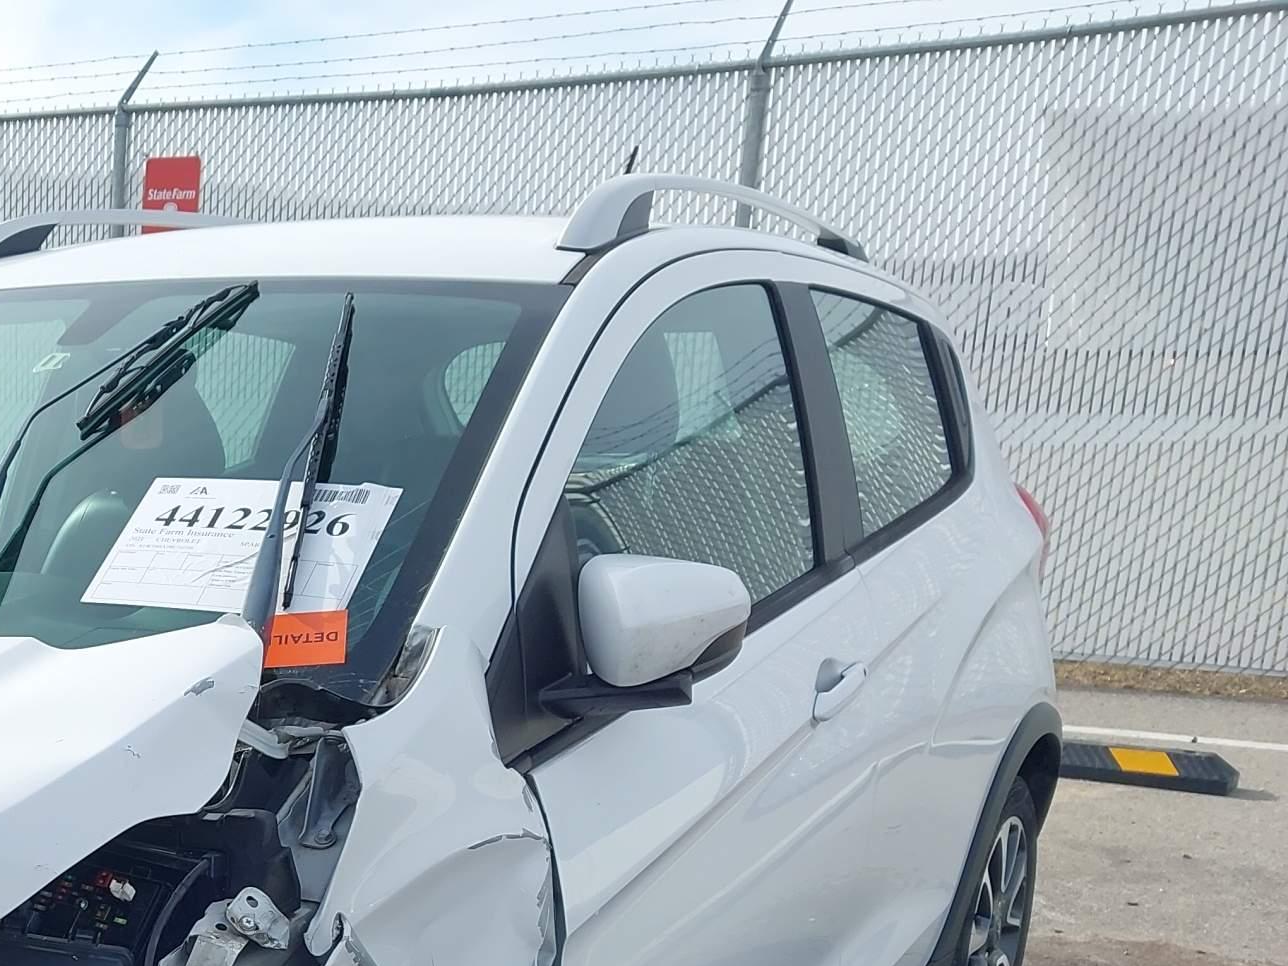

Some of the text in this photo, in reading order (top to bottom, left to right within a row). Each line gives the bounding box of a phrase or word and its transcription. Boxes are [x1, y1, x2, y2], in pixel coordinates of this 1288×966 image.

[155, 504, 358, 537] 44122926
[133, 526, 234, 539] State Farm Insurance
[273, 631, 339, 646] DETAIL
